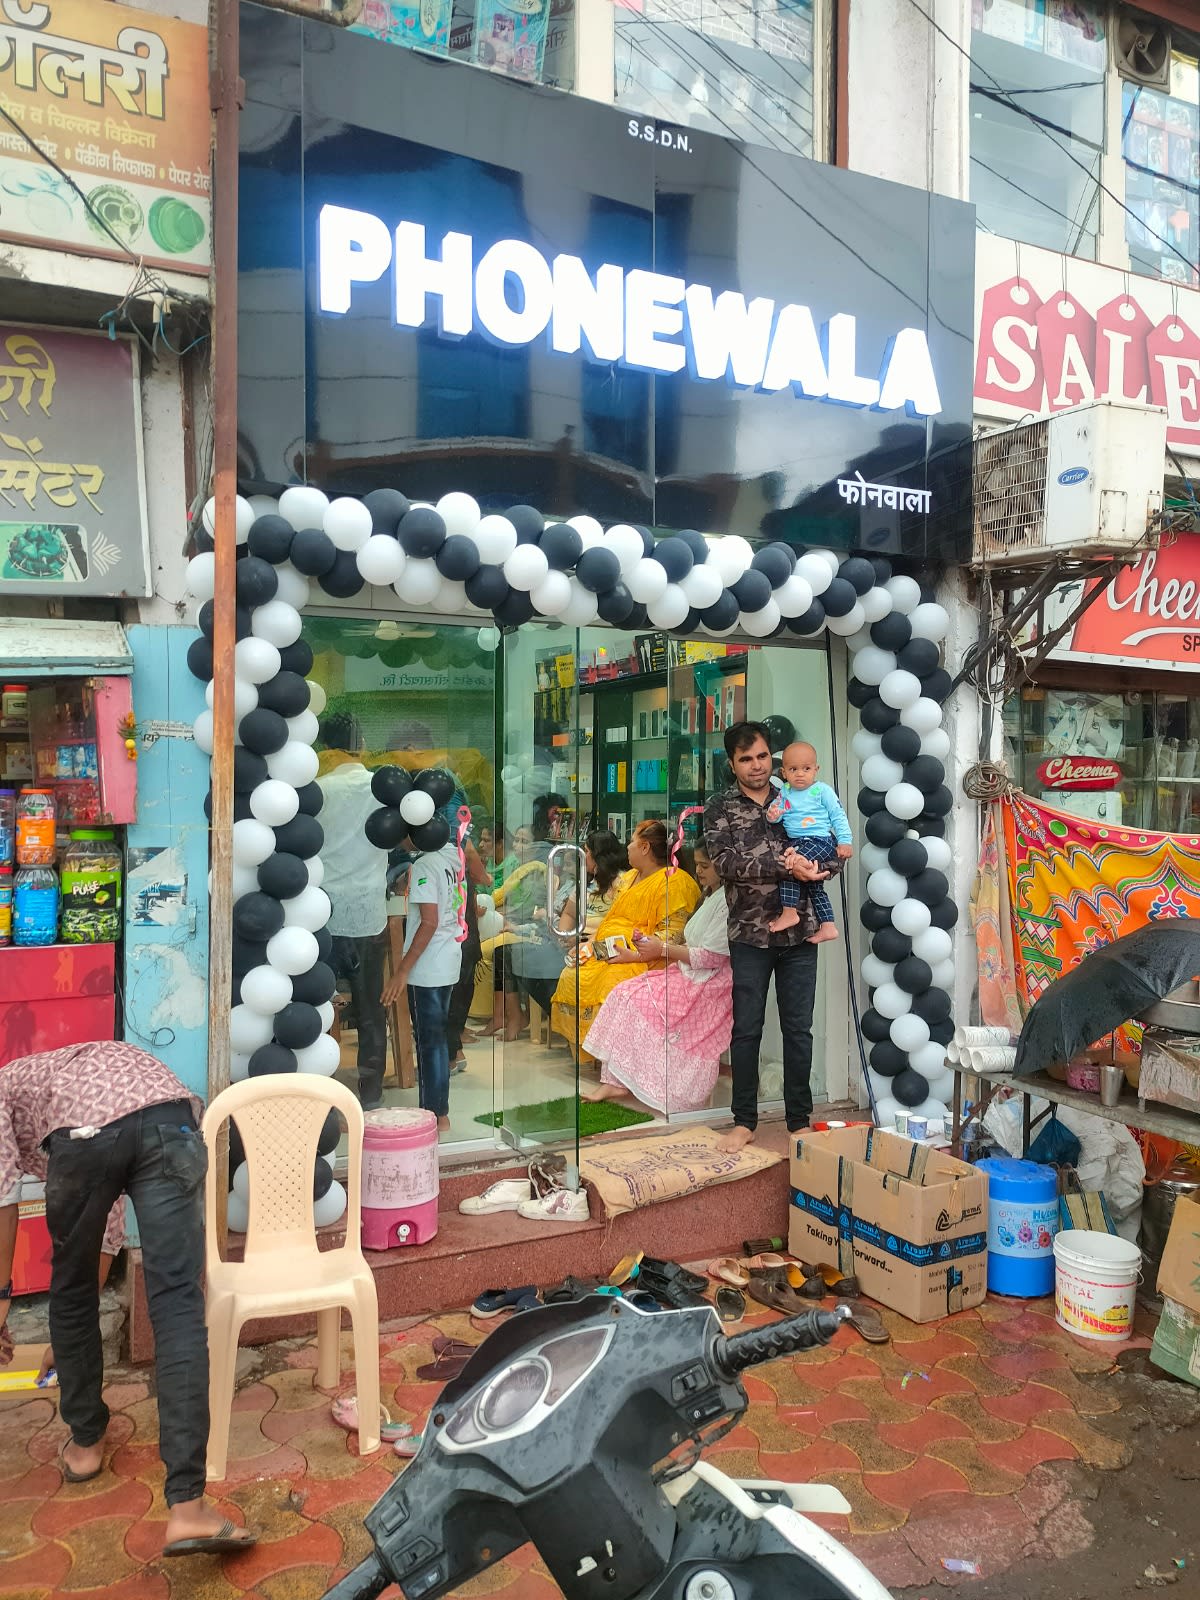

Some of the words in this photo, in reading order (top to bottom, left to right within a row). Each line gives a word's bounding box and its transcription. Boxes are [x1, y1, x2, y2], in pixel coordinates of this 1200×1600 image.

[627, 119, 693, 154] S.S.D.N.
[318, 203, 942, 418] PHONEWALA
[985, 315, 1200, 432] SALE
[837, 470, 932, 514] फोनवाला
[1106, 550, 1200, 621] Chee
[1045, 757, 1117, 781] Cheema
[72, 880, 100, 897] PULSE
[806, 1224, 833, 1247] Taking
